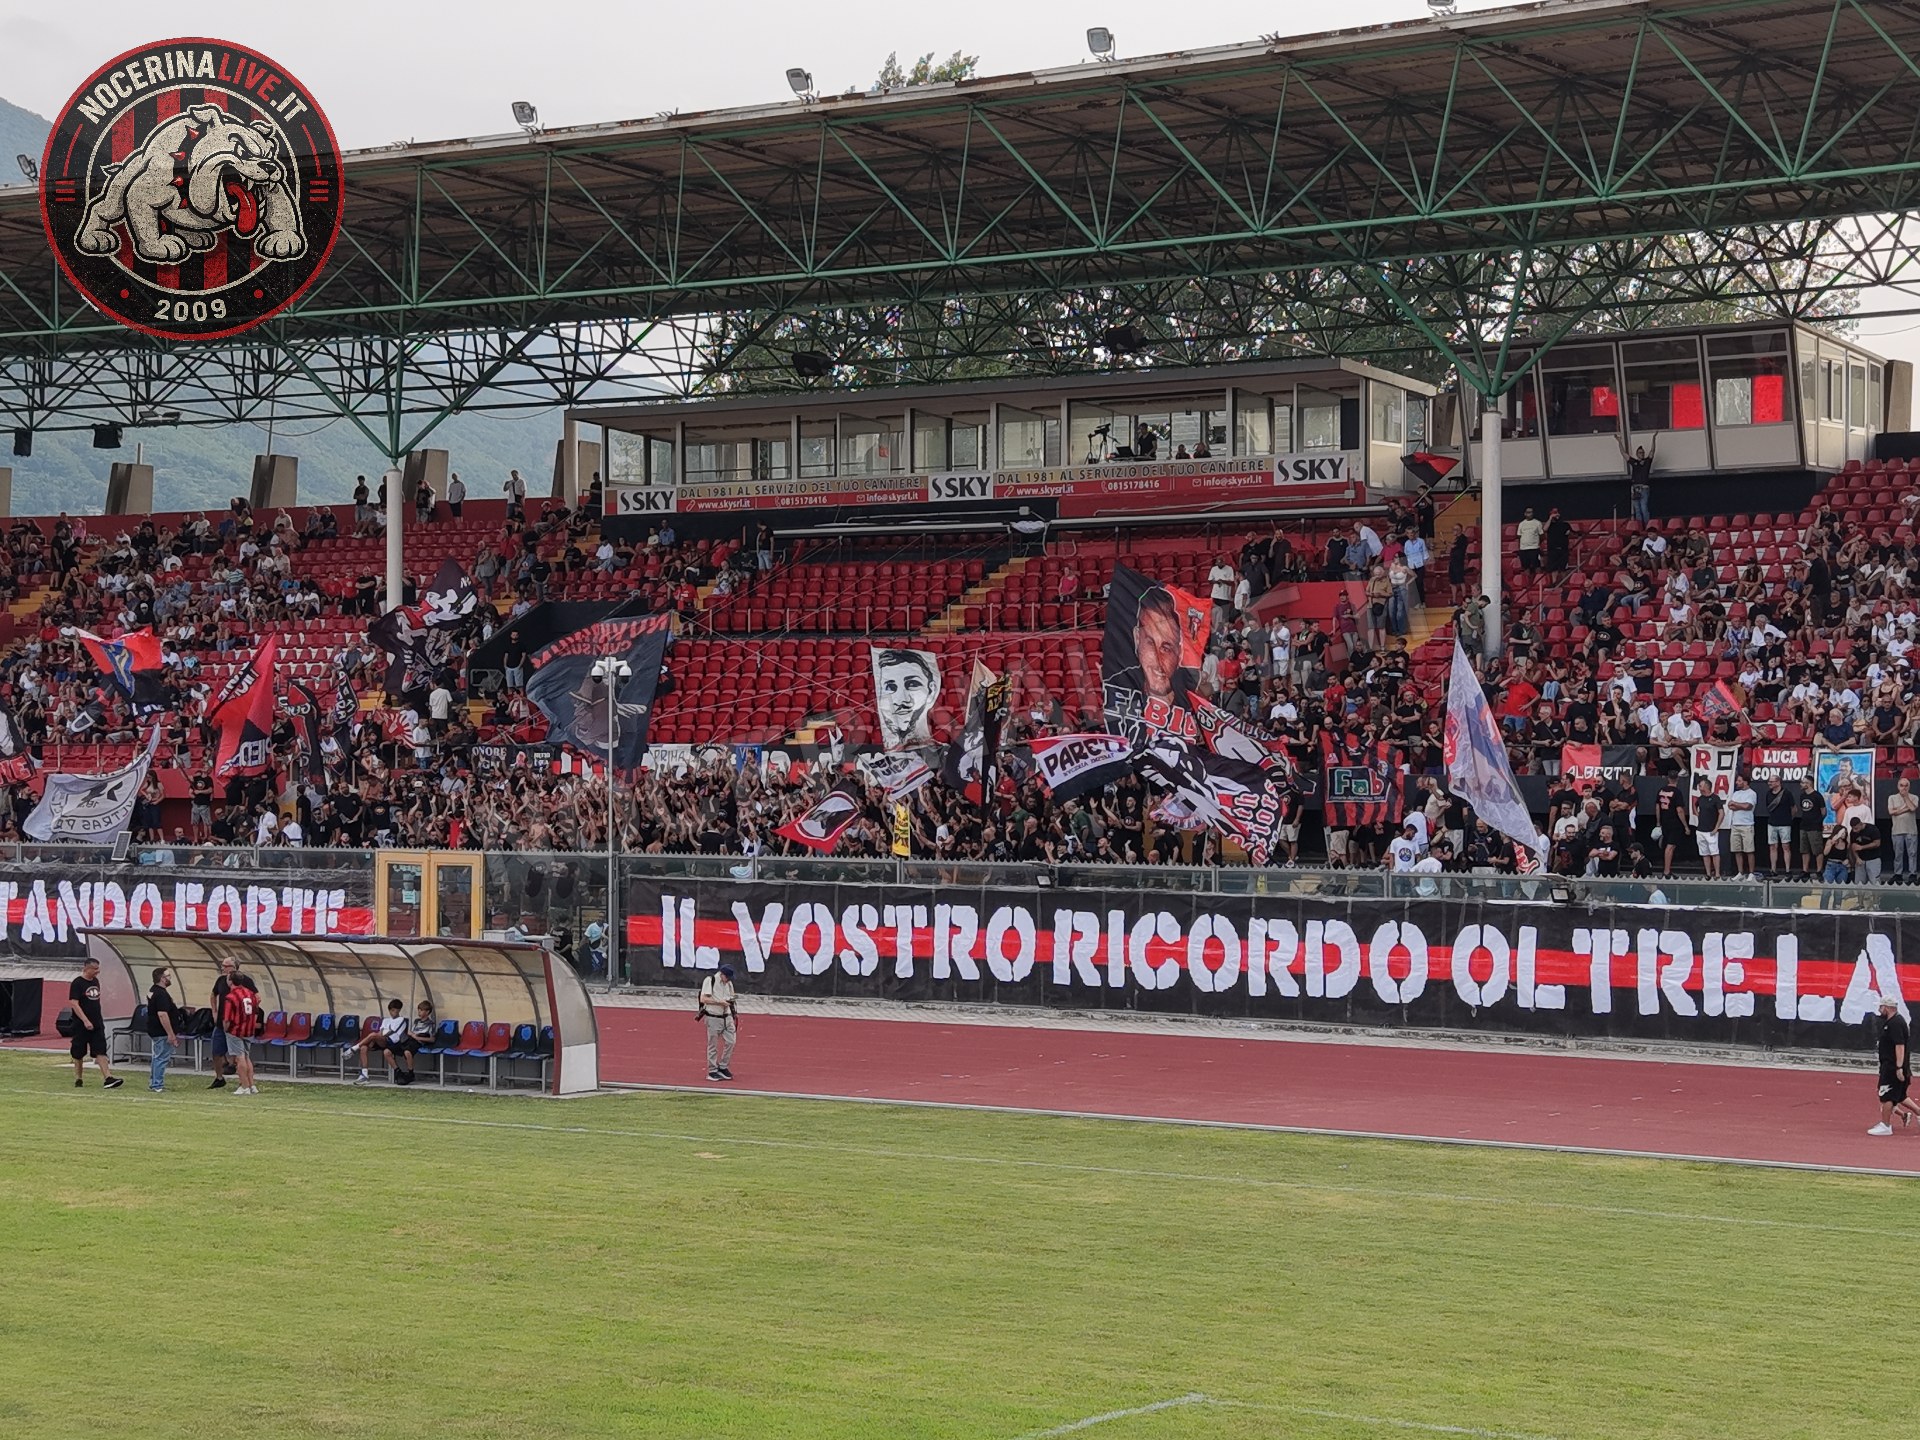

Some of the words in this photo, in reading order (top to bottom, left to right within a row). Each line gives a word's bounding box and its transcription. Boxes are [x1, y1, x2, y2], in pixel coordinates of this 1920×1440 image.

[999, 473, 1020, 483] DAL
[1027, 472, 1053, 482] 1981
[1060, 470, 1074, 481] AL
[1080, 467, 1136, 480] SERVIZIO
[1143, 466, 1165, 476] DEL
[1169, 464, 1194, 475] TUO
[1200, 460, 1268, 473] CANTIERE.
[1293, 458, 1344, 481] SKY
[681, 488, 701, 498] DAL
[708, 487, 732, 497] 1981
[737, 486, 750, 495] AL
[755, 483, 807, 494] SERVIZIO
[812, 482, 831, 492] DEL
[838, 481, 859, 491] TUO
[945, 476, 990, 497] SKY
[1017, 484, 1075, 496] www.skysrl.it
[633, 491, 675, 511] SKY
[698, 498, 751, 511] www.skysrl.it
[1763, 750, 1798, 764] LUCA
[1334, 768, 1384, 796] Fab
[1752, 767, 1781, 781] CON
[1782, 766, 1808, 781] NOI
[661, 894, 720, 970] IL
[731, 900, 1037, 983] VOSTRO
[1052, 908, 1429, 1004] RICORDO
[242, 997, 253, 1015] 6
